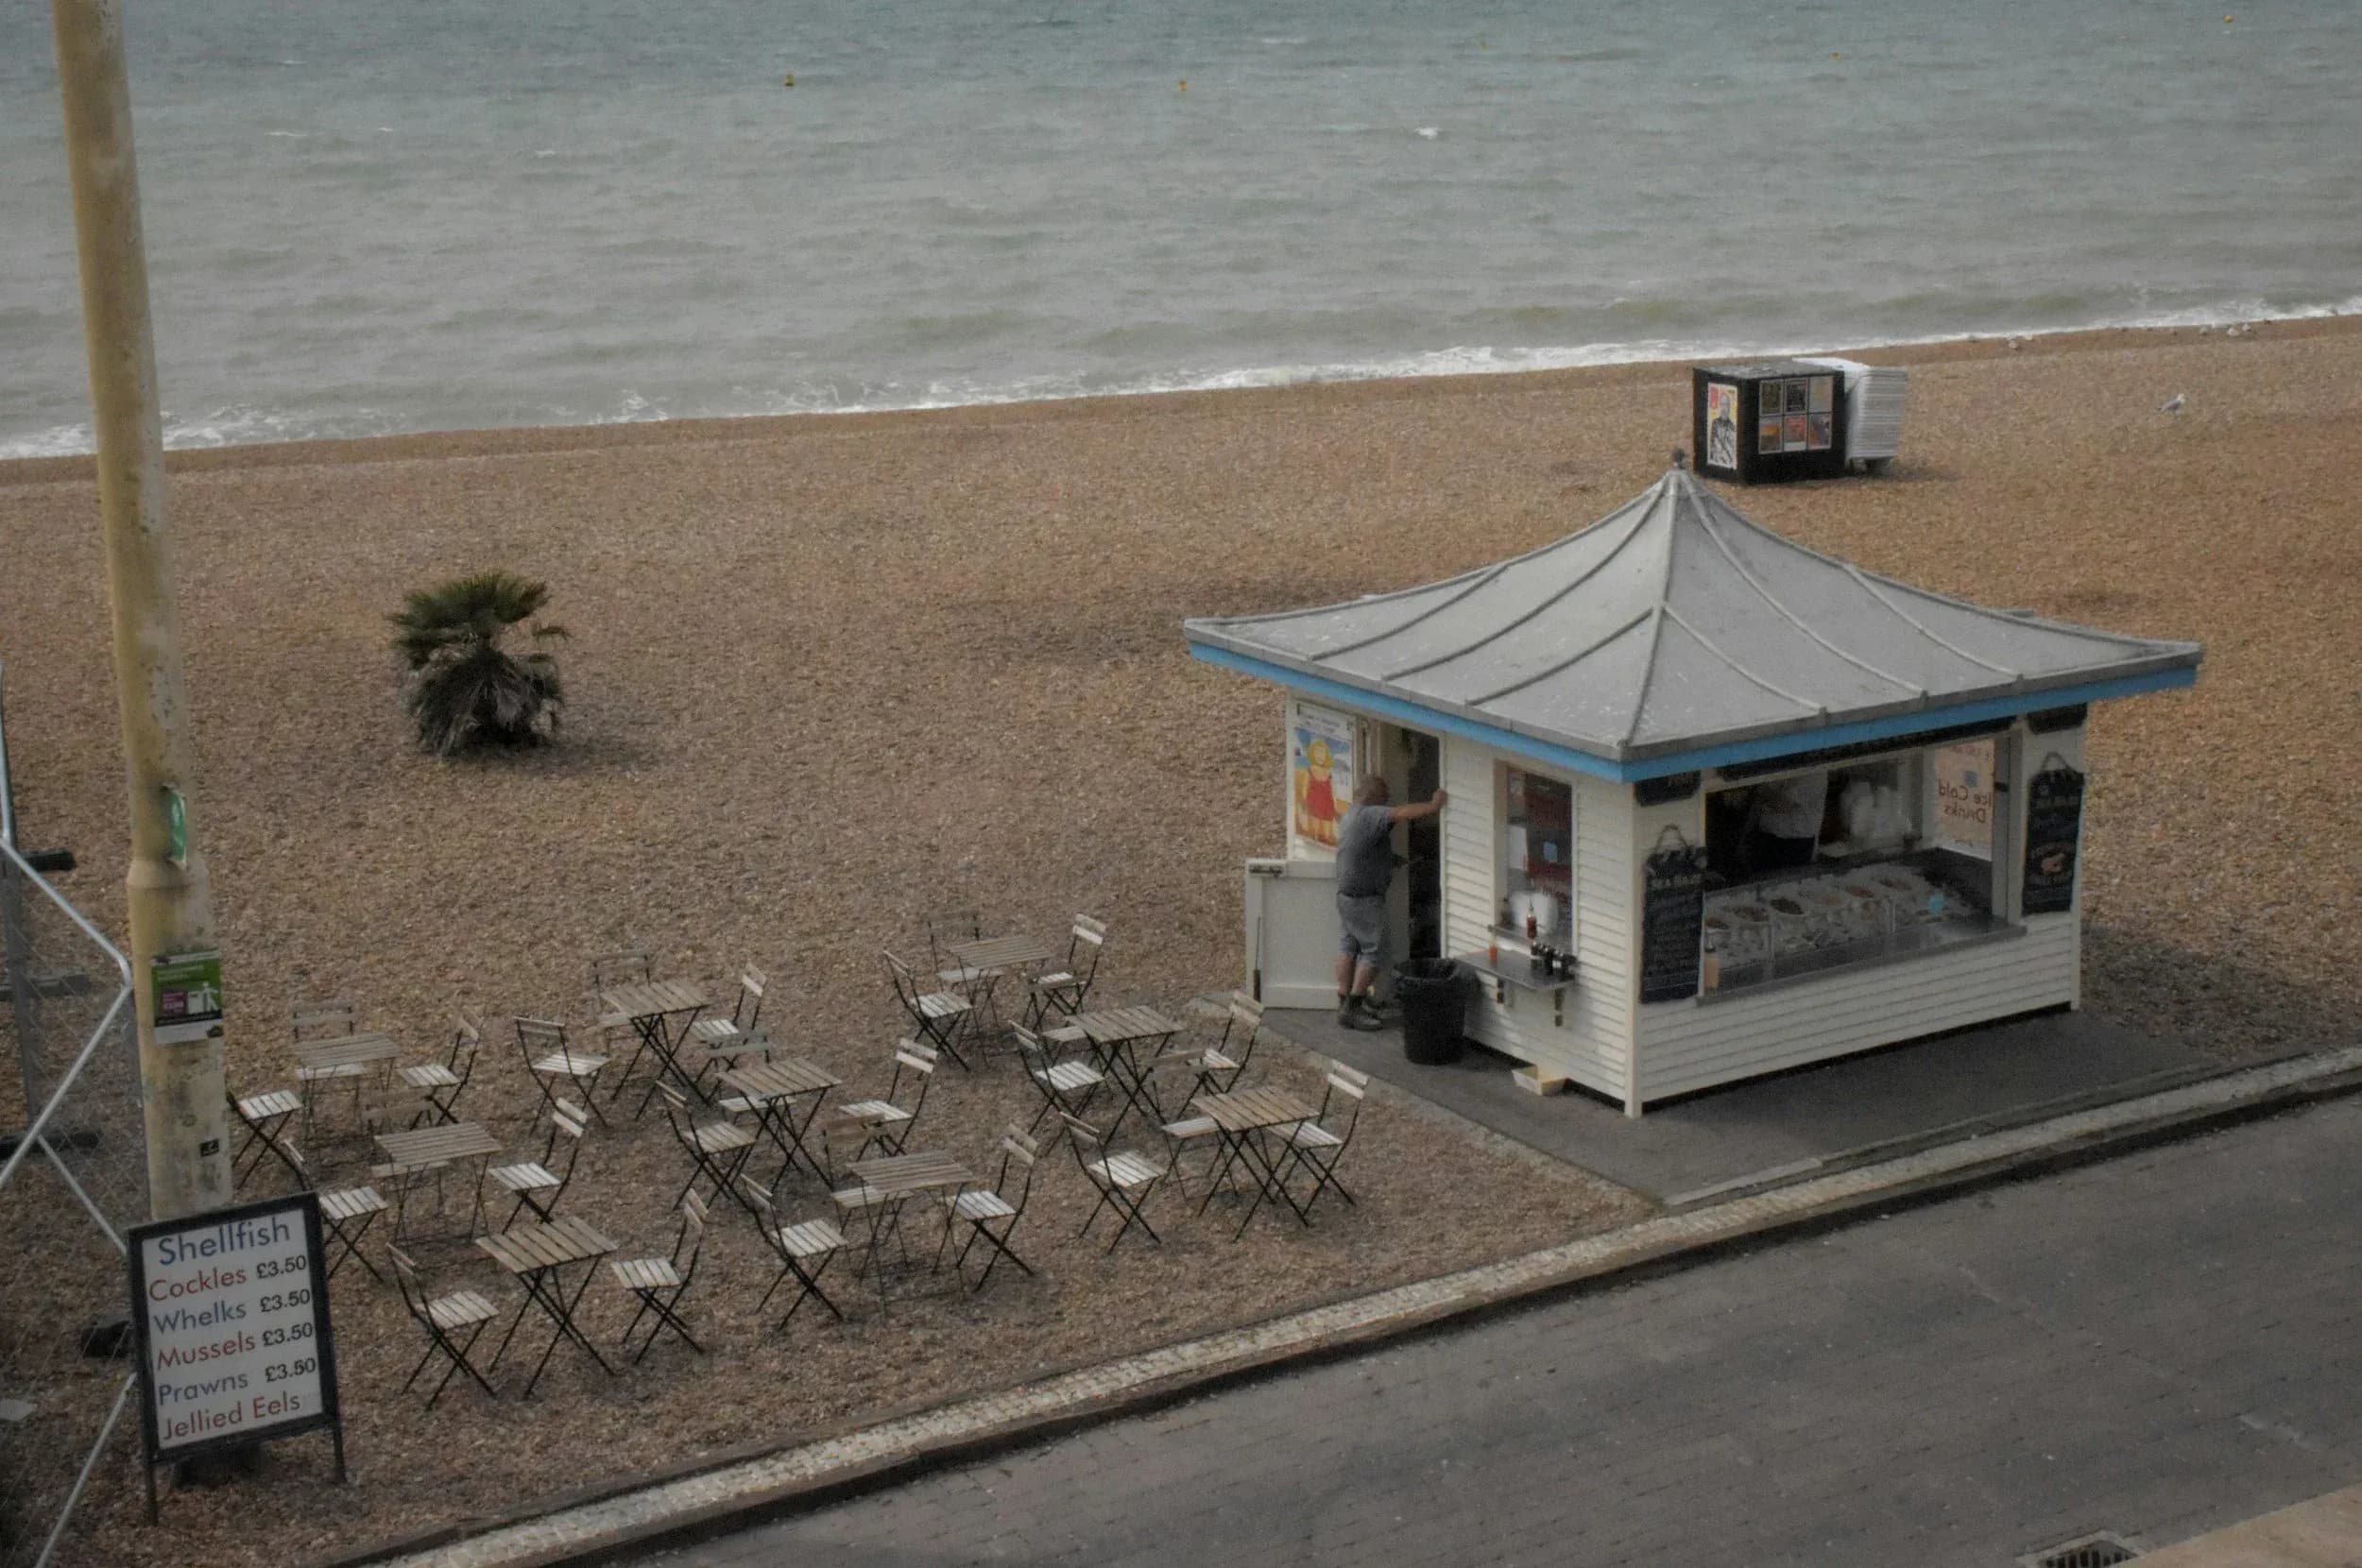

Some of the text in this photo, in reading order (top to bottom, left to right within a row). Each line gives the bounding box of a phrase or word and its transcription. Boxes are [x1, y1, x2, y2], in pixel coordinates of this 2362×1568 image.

[159, 1216, 290, 1266] Shellfish
[149, 1254, 307, 1301] Cockles £3.50
[153, 1288, 311, 1333] Whelks £3.50
[157, 1322, 314, 1371] Mussels £3.50
[159, 1357, 317, 1406] Prawns £3.50
[163, 1390, 300, 1440] Jellied Eels
